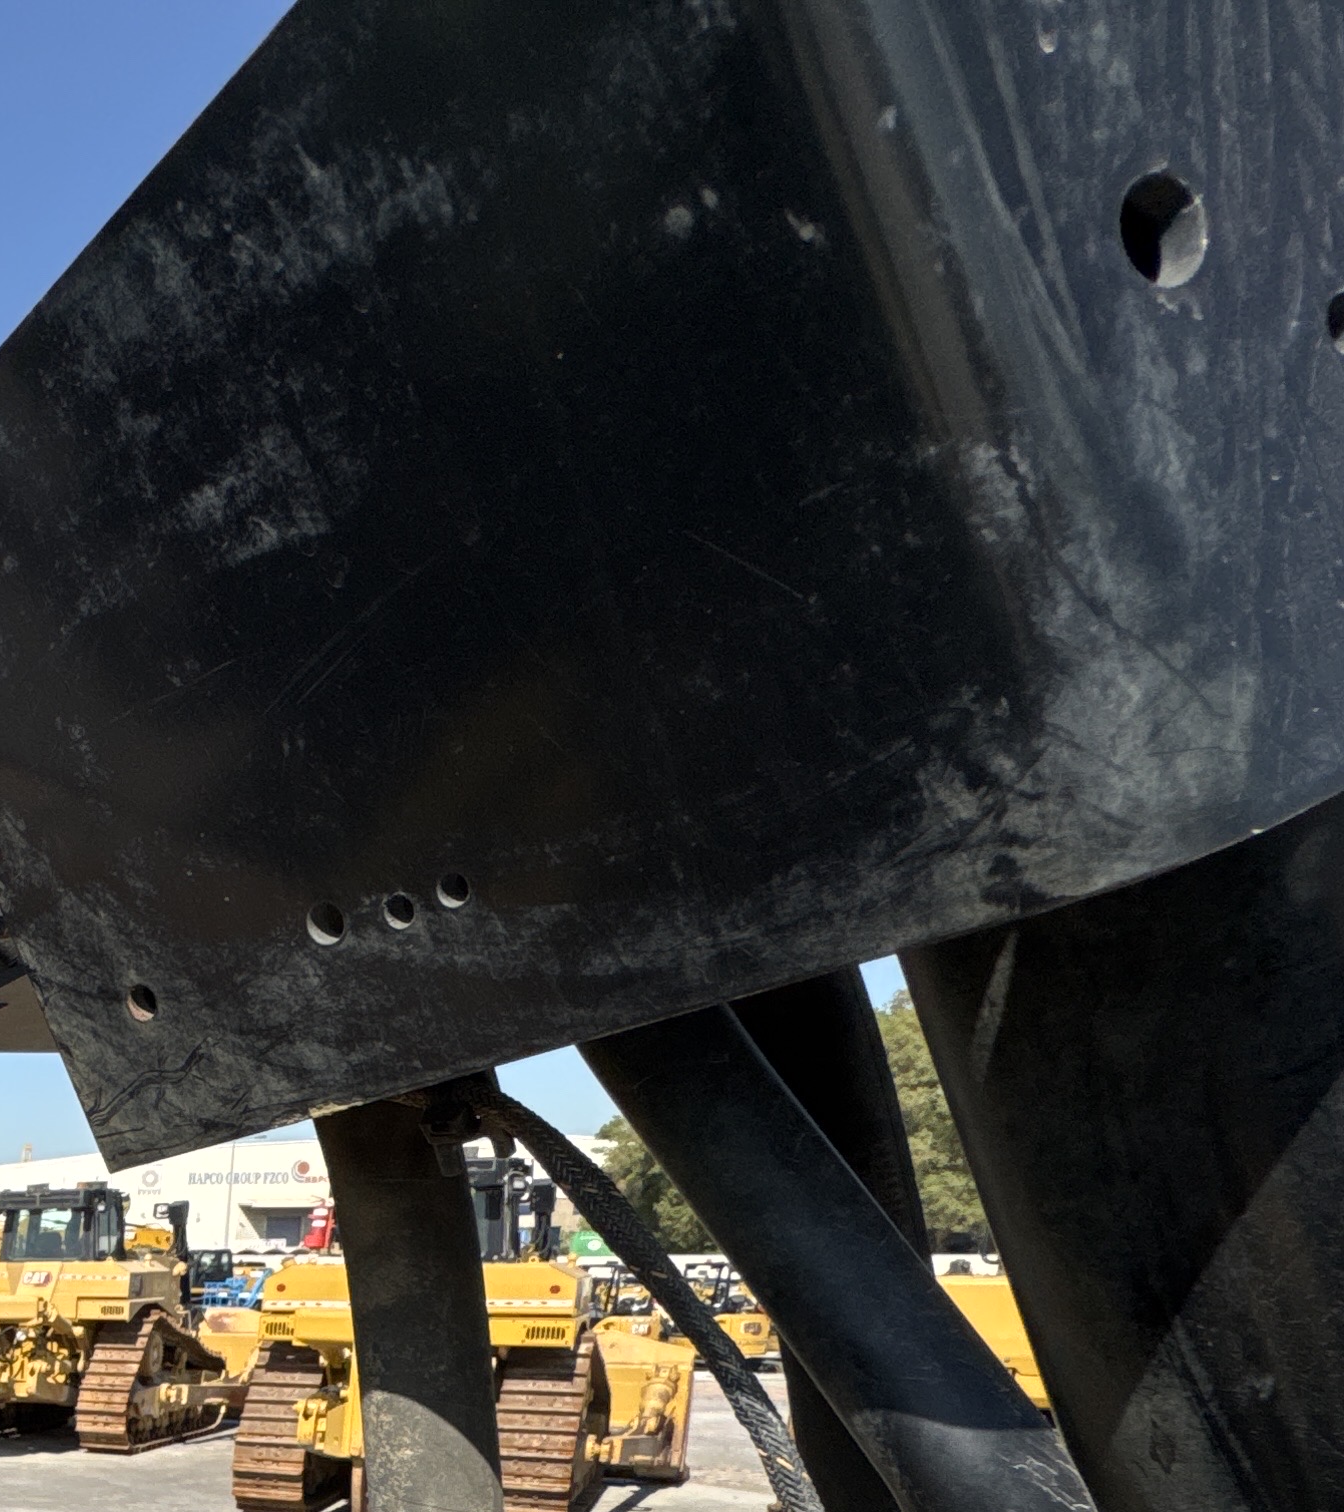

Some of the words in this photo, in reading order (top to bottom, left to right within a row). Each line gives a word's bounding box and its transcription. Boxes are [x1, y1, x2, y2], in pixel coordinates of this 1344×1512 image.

[188, 1172, 223, 1185] HAPCO
[226, 1172, 261, 1185] GROUP
[263, 1172, 289, 1185] FZCO
[22, 1271, 50, 1285] CAT
